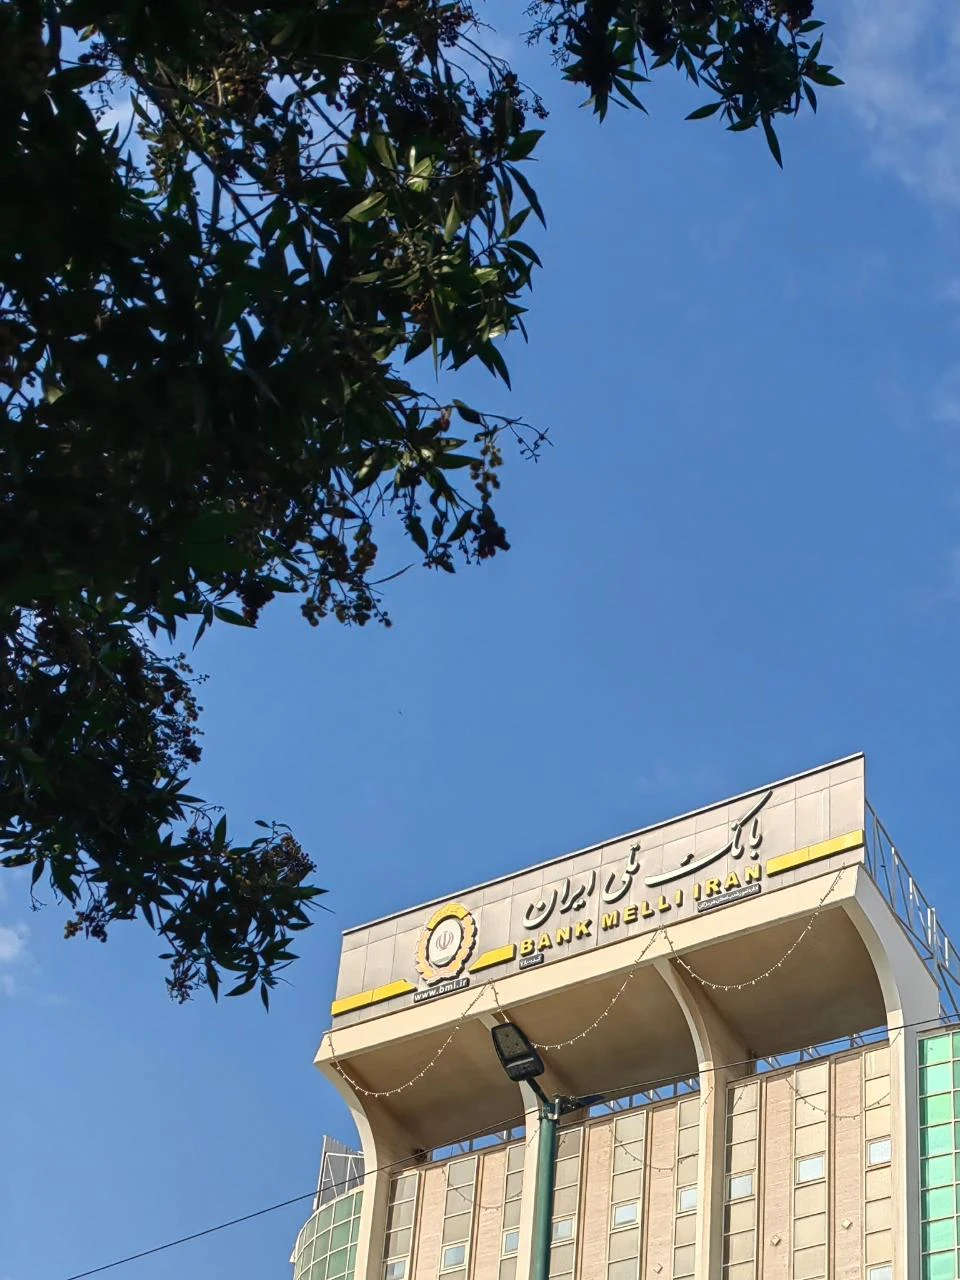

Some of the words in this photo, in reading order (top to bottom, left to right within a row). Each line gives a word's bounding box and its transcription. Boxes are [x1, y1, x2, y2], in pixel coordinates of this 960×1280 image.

[644, 790, 773, 887] بانک
[520, 918, 593, 957] BANK
[601, 889, 683, 931] MELLI
[693, 863, 762, 902] IRAN
[523, 870, 596, 929] ایران
